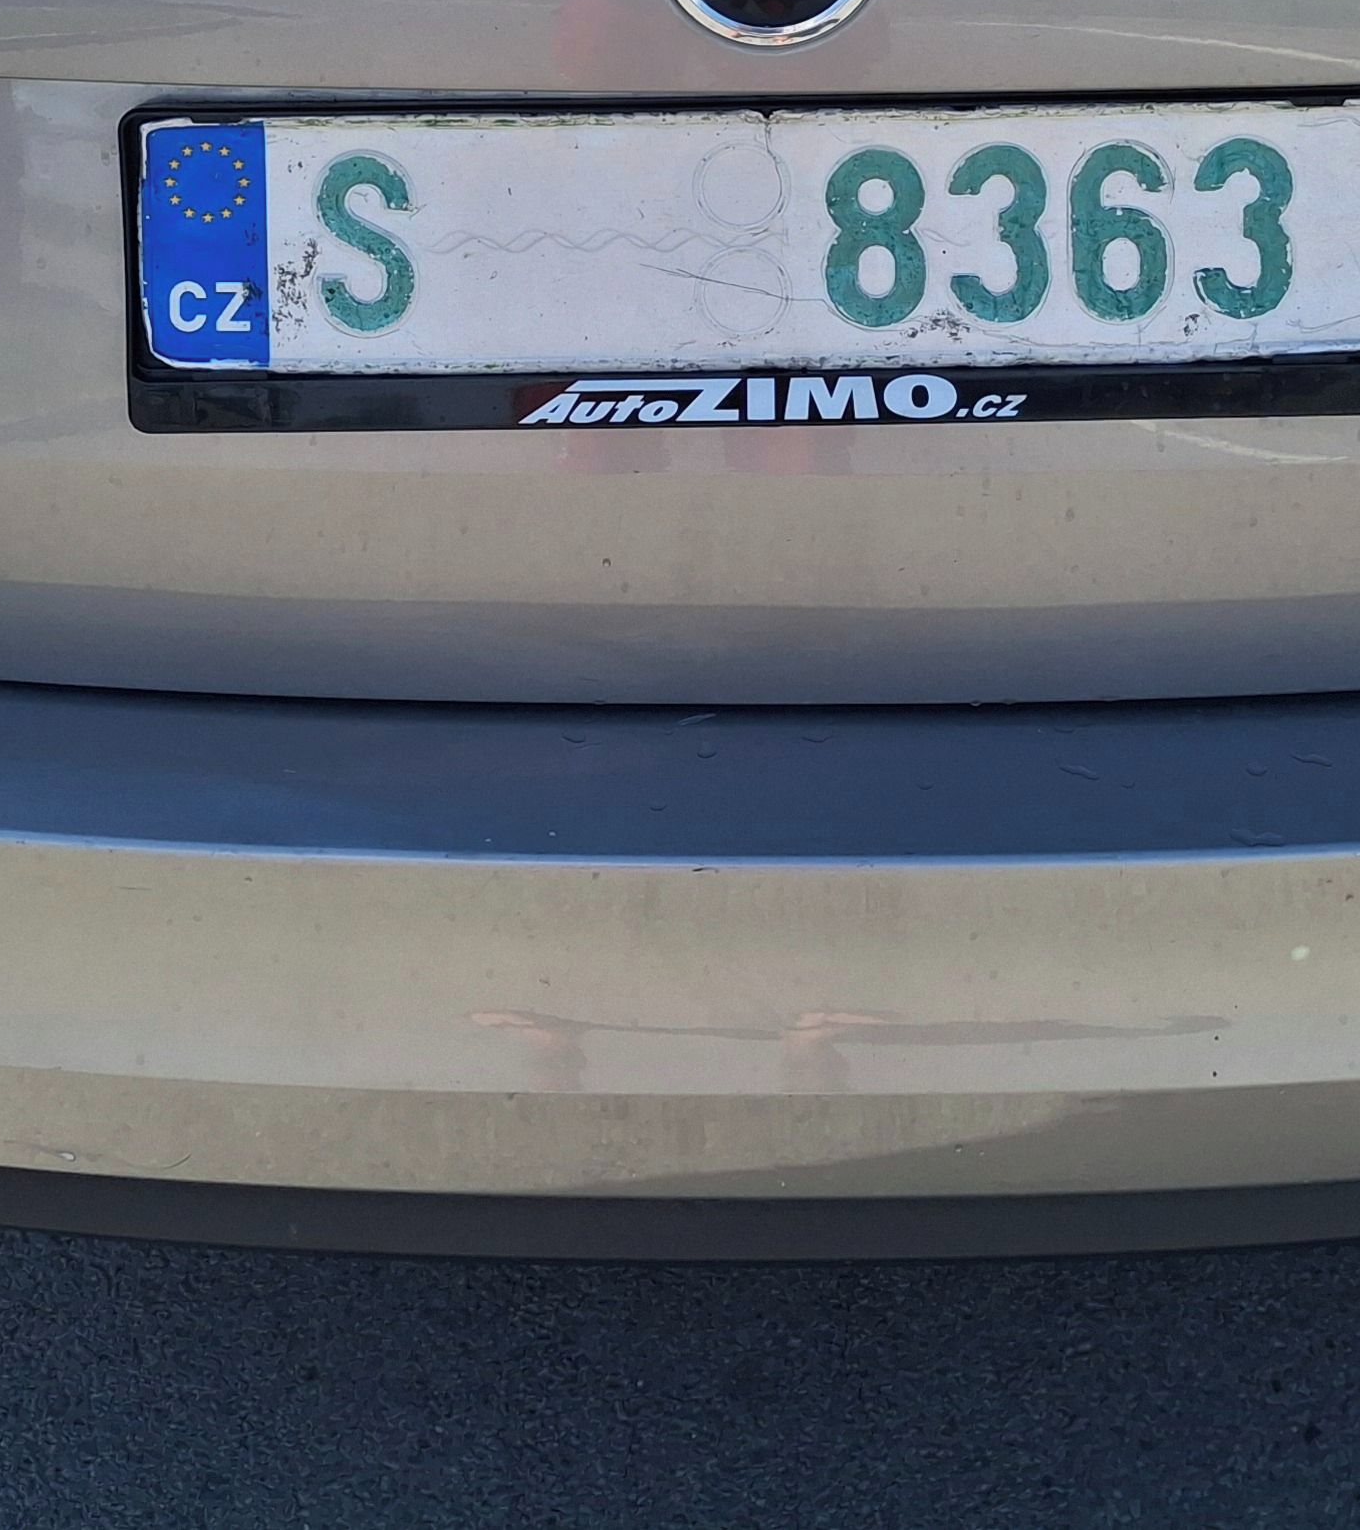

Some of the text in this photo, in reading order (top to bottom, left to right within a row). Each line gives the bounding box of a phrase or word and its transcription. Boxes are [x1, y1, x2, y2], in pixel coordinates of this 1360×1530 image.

[316, 138, 1293, 332] S 8363
[169, 281, 251, 333] CZ
